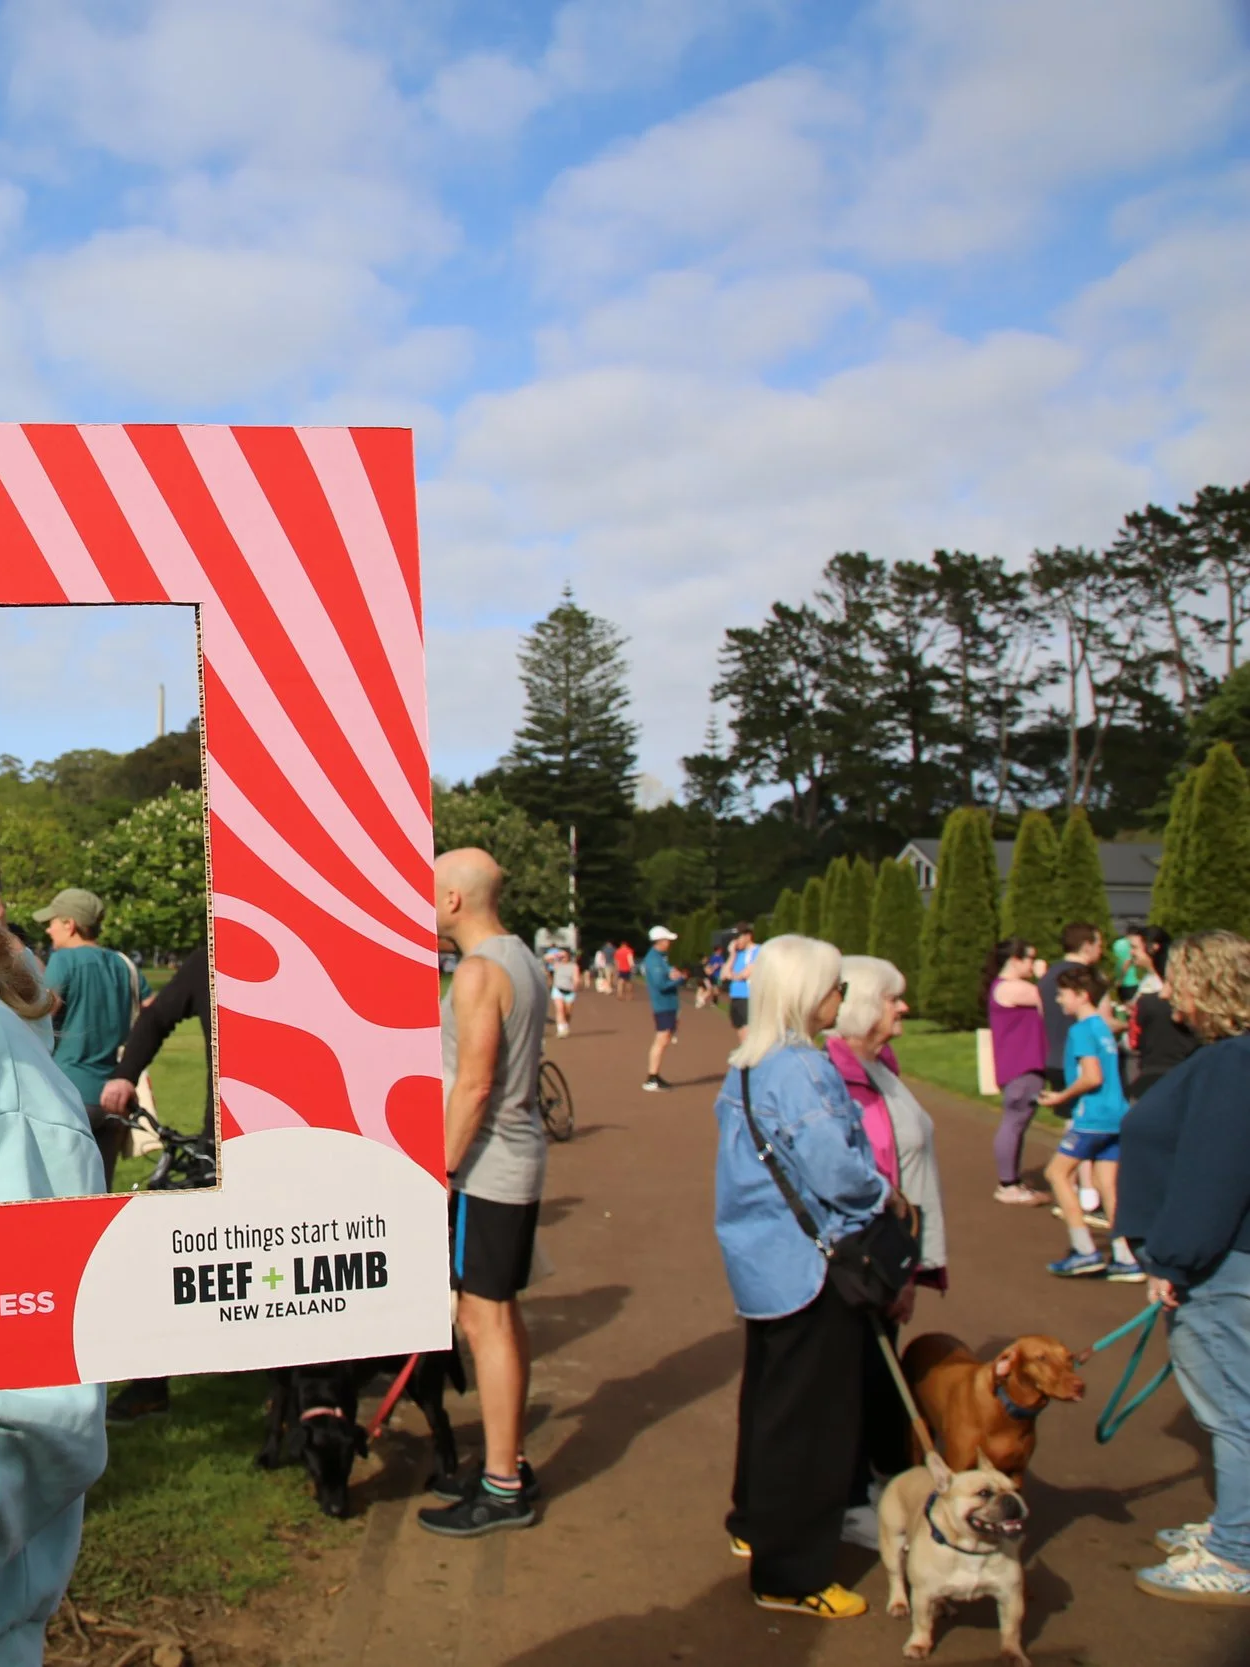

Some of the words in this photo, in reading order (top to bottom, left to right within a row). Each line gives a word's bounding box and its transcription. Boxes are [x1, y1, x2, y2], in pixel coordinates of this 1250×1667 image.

[172, 1227, 218, 1254] Good
[224, 1221, 285, 1251] things
[291, 1218, 340, 1244] start
[346, 1214, 386, 1240] with
[172, 1261, 253, 1305] BEEF
[293, 1251, 388, 1295] LAMB
[219, 1303, 260, 1322] NEW
[265, 1297, 347, 1318] ZEALAND
